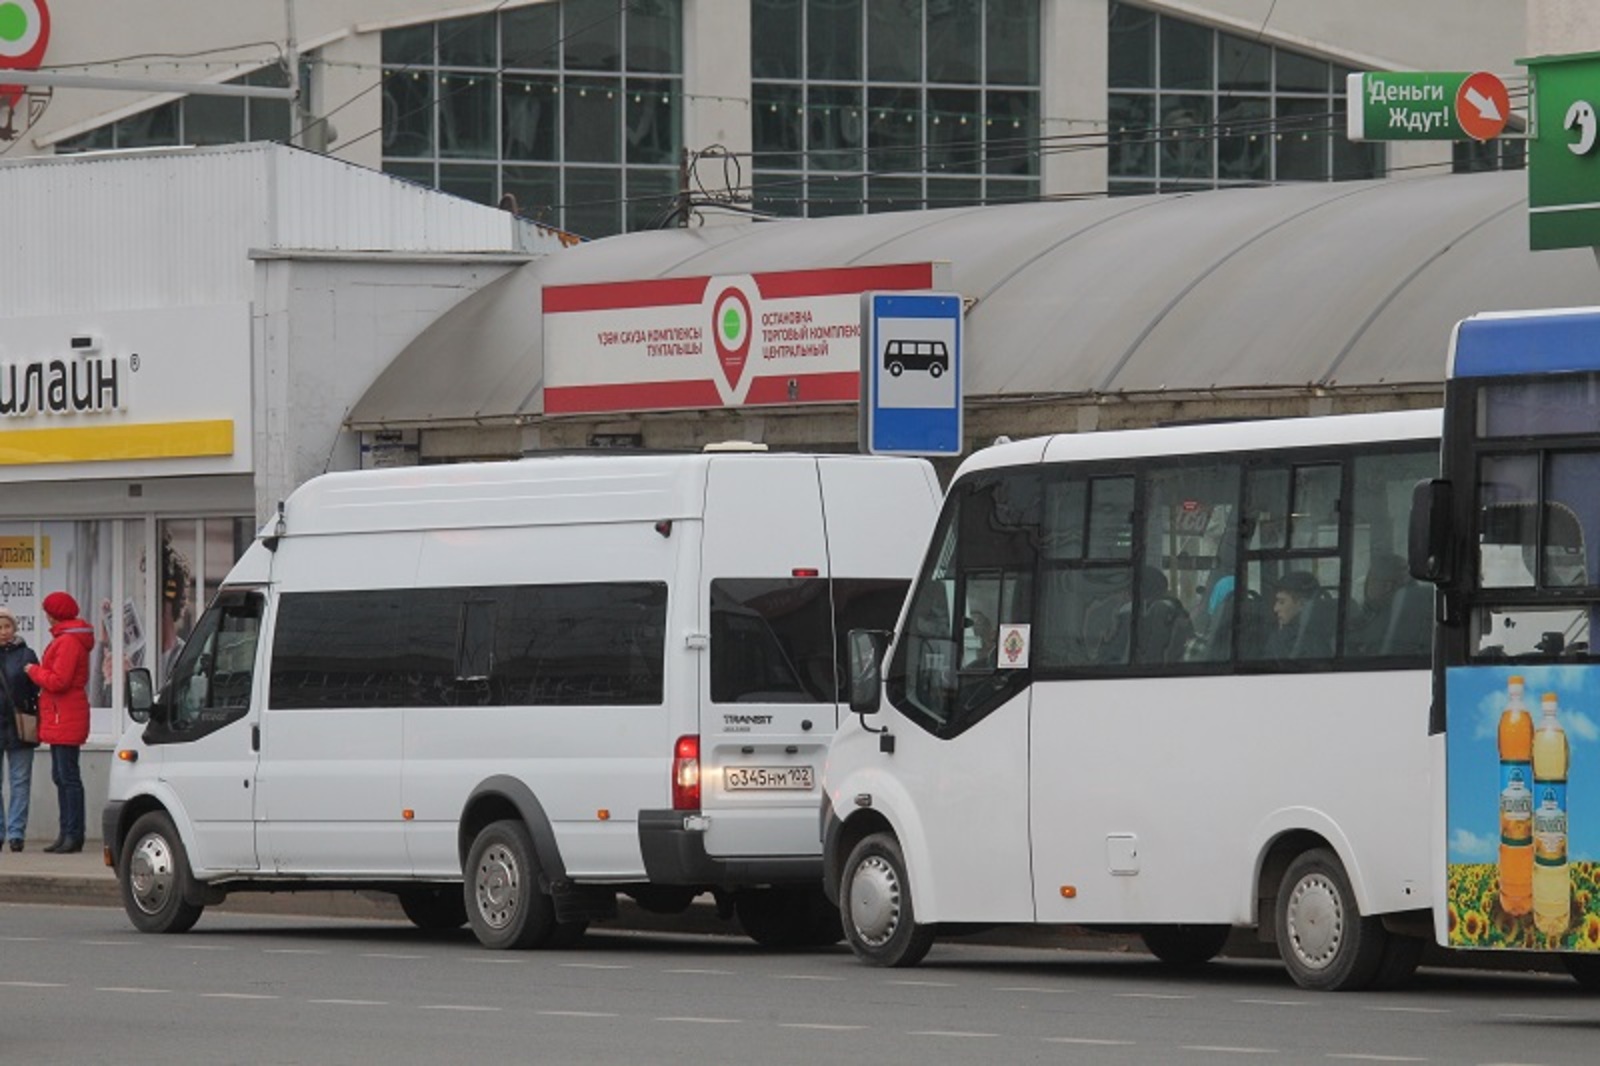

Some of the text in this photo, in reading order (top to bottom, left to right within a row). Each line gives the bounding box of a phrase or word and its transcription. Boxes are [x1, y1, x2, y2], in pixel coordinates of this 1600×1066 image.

[1370, 80, 1444, 104] Деньги
[1388, 106, 1449, 132] Ждут!
[761, 310, 812, 326] ОСТАНОВКА
[761, 327, 808, 343] ТОРГОВЫЙ
[761, 341, 829, 361] ЦЕНТРАЛЬНЫЙ
[723, 715, 773, 725] TRANSIT
